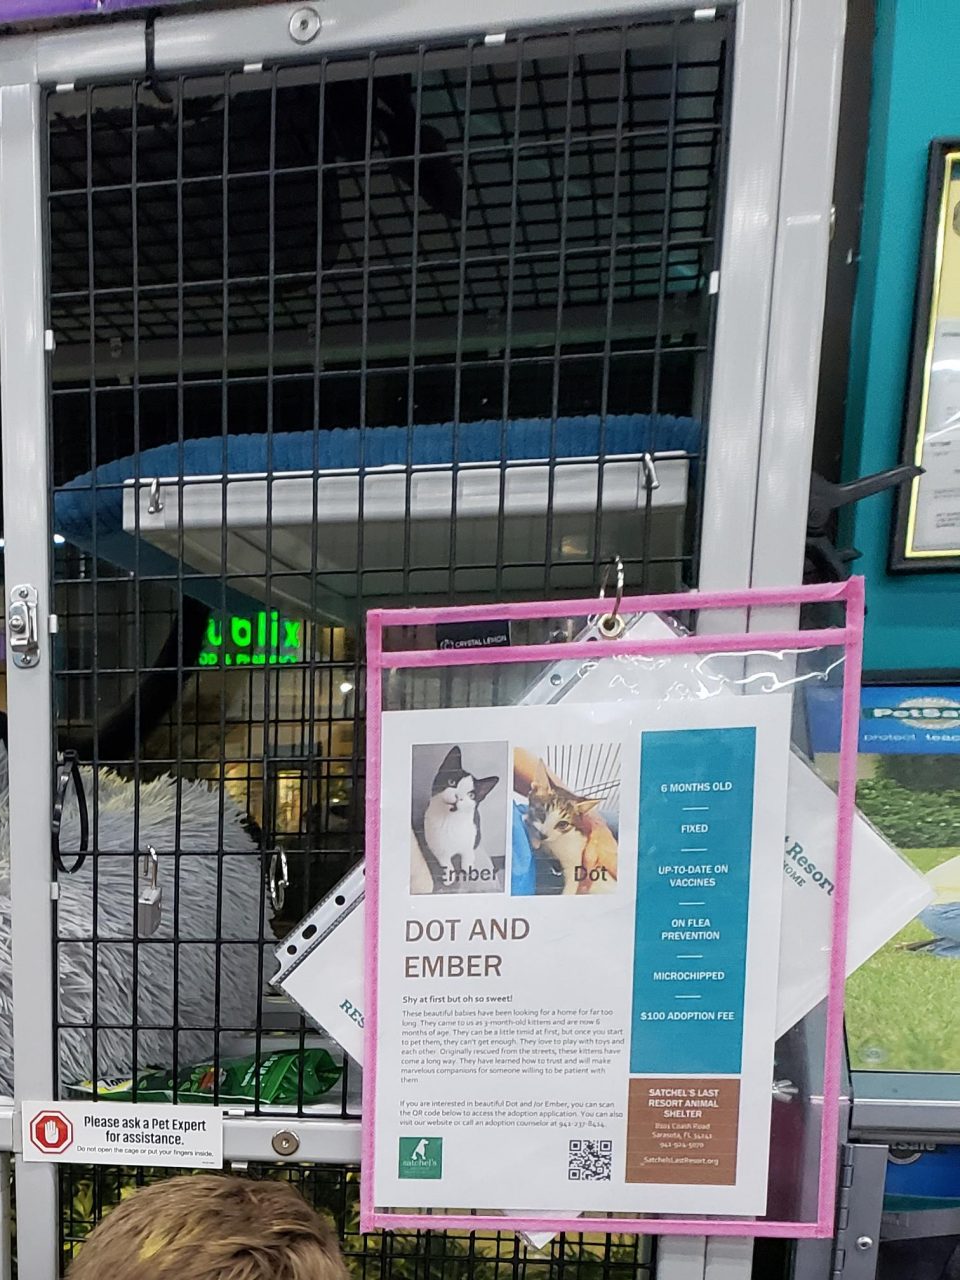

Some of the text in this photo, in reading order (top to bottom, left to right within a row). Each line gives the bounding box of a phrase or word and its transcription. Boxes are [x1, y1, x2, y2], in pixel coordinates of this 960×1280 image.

[873, 707, 960, 719] PetSa
[661, 781, 732, 793] 6 MONTHS OLD
[681, 824, 708, 833] FIXED
[440, 865, 498, 882] Ember
[574, 865, 608, 882] Dot
[658, 864, 728, 875] UP-TO-DATE ON
[670, 878, 716, 887] VACCINES
[671, 918, 711, 928] ON FLEA
[405, 917, 530, 942] DOT AND
[661, 931, 720, 940] PREVENTION
[404, 955, 502, 978] EMBER
[653, 971, 725, 981] MICROCHIPPED
[402, 996, 418, 1005] Shy
[429, 995, 445, 1003] first
[447, 995, 460, 1003] but
[462, 995, 473, 1003] oh
[486, 994, 513, 1003] sweet!
[513, 1009, 538, 1017] looking
[640, 1011, 735, 1021] $100 ADOPTION FEE
[649, 1088, 719, 1097] SATCHEL'S LAST
[649, 1099, 719, 1108] RESORT ANIMAL
[663, 1110, 702, 1118] SHELTER
[84, 1115, 206, 1133] Please ask a Pet Expert
[105, 1130, 184, 1146] for assistance.
[173, 1149, 193, 1157] fingers
[195, 1150, 214, 1158] inside.
